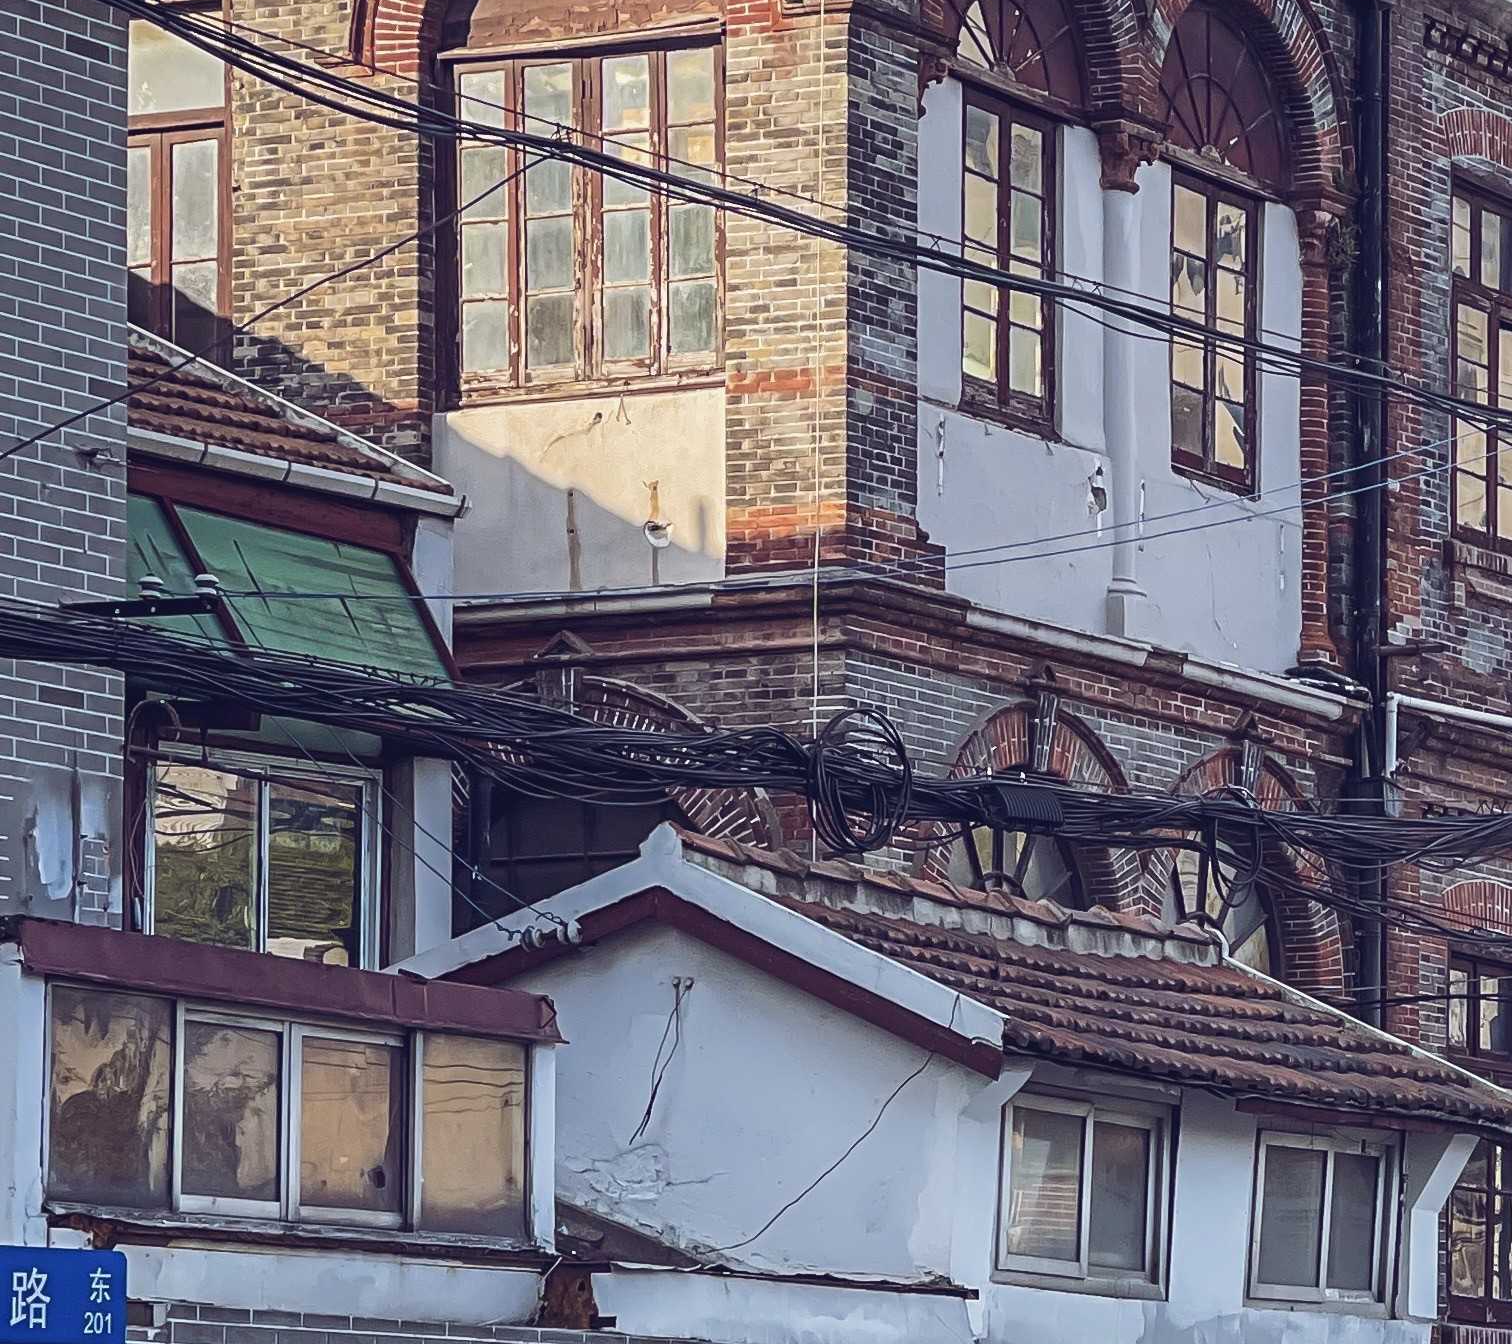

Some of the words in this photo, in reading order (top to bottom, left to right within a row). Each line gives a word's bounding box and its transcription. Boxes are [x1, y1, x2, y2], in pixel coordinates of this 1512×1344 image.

[9, 1267, 51, 1329] 路
[89, 1267, 112, 1304] 东
[83, 1312, 112, 1334] 201
